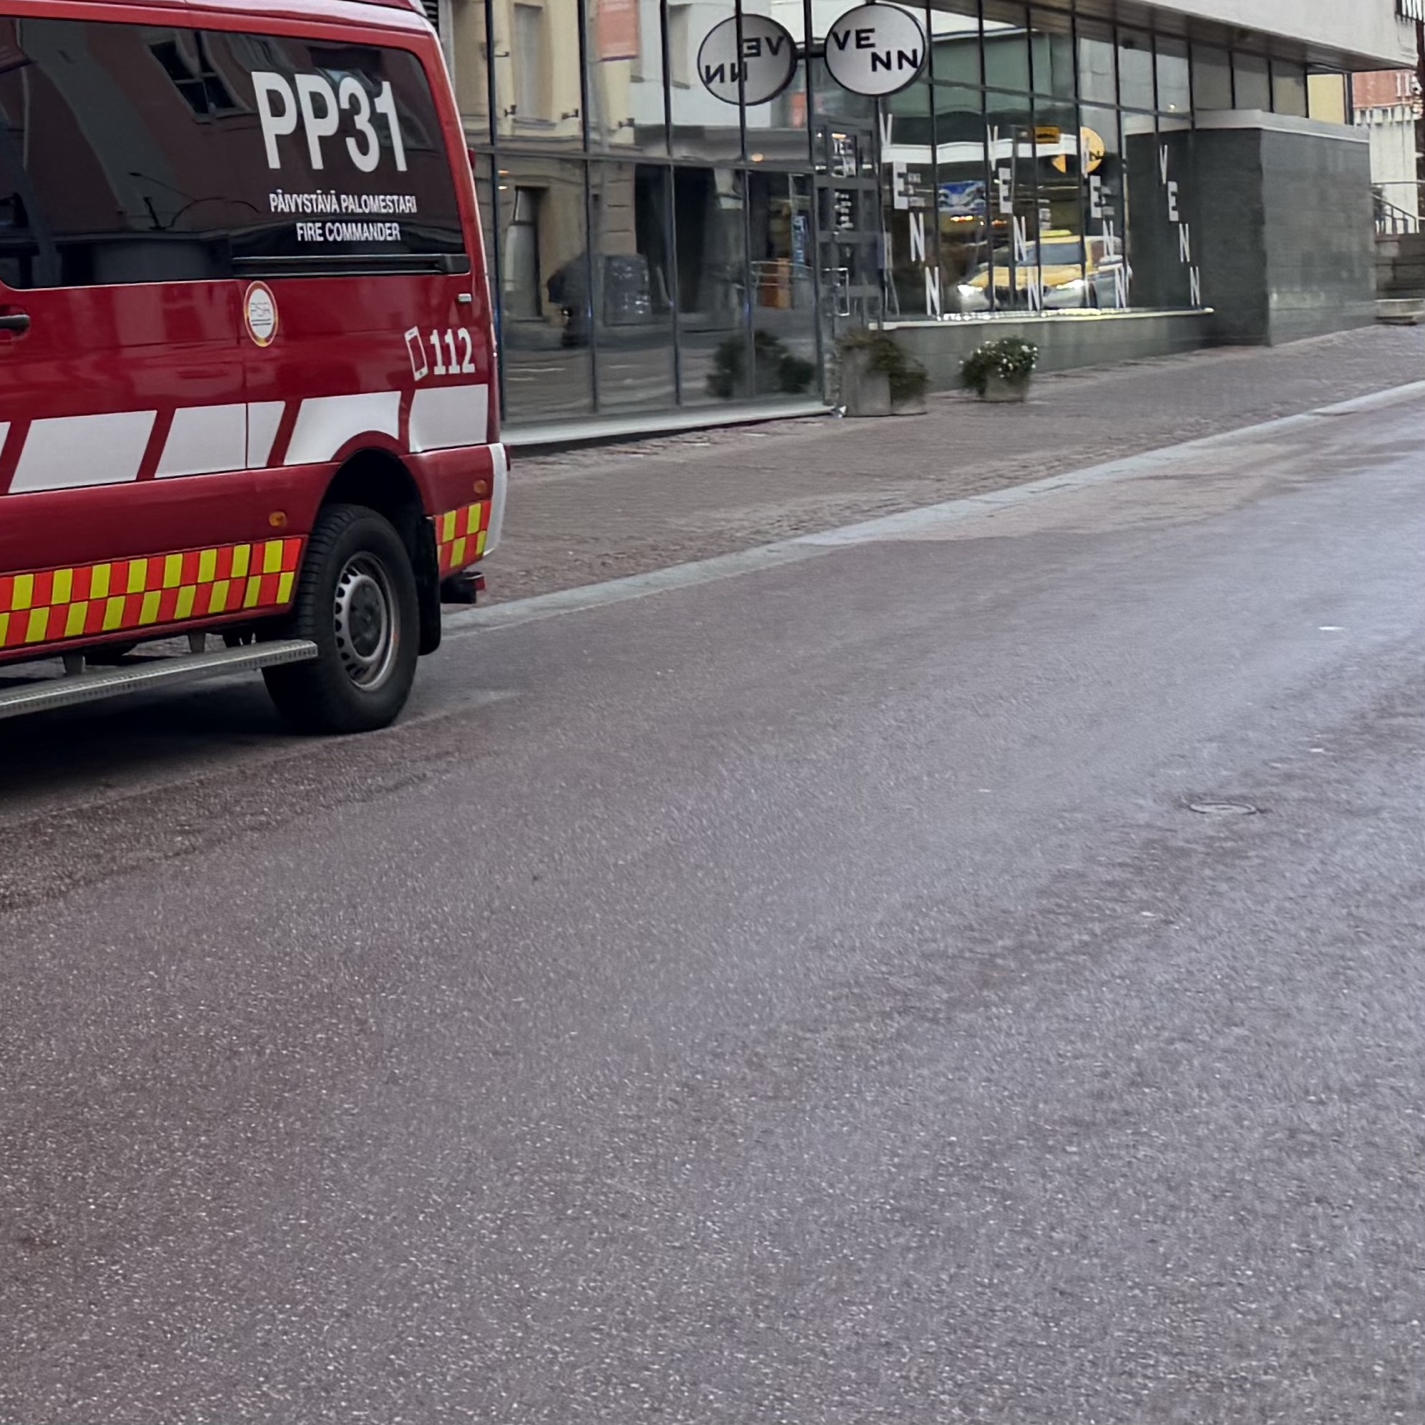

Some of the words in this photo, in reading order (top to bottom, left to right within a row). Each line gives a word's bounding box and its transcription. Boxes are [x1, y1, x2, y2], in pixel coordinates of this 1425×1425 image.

[831, 28, 876, 51] VE
[871, 49, 918, 72] NN
[251, 71, 408, 173] PP31
[269, 189, 340, 214] PÄIVYSTÄVÄ
[341, 194, 418, 214] PALOMESTARI
[296, 222, 324, 242] FIRE
[325, 222, 401, 242] COMMANDER
[430, 326, 476, 375] 112
